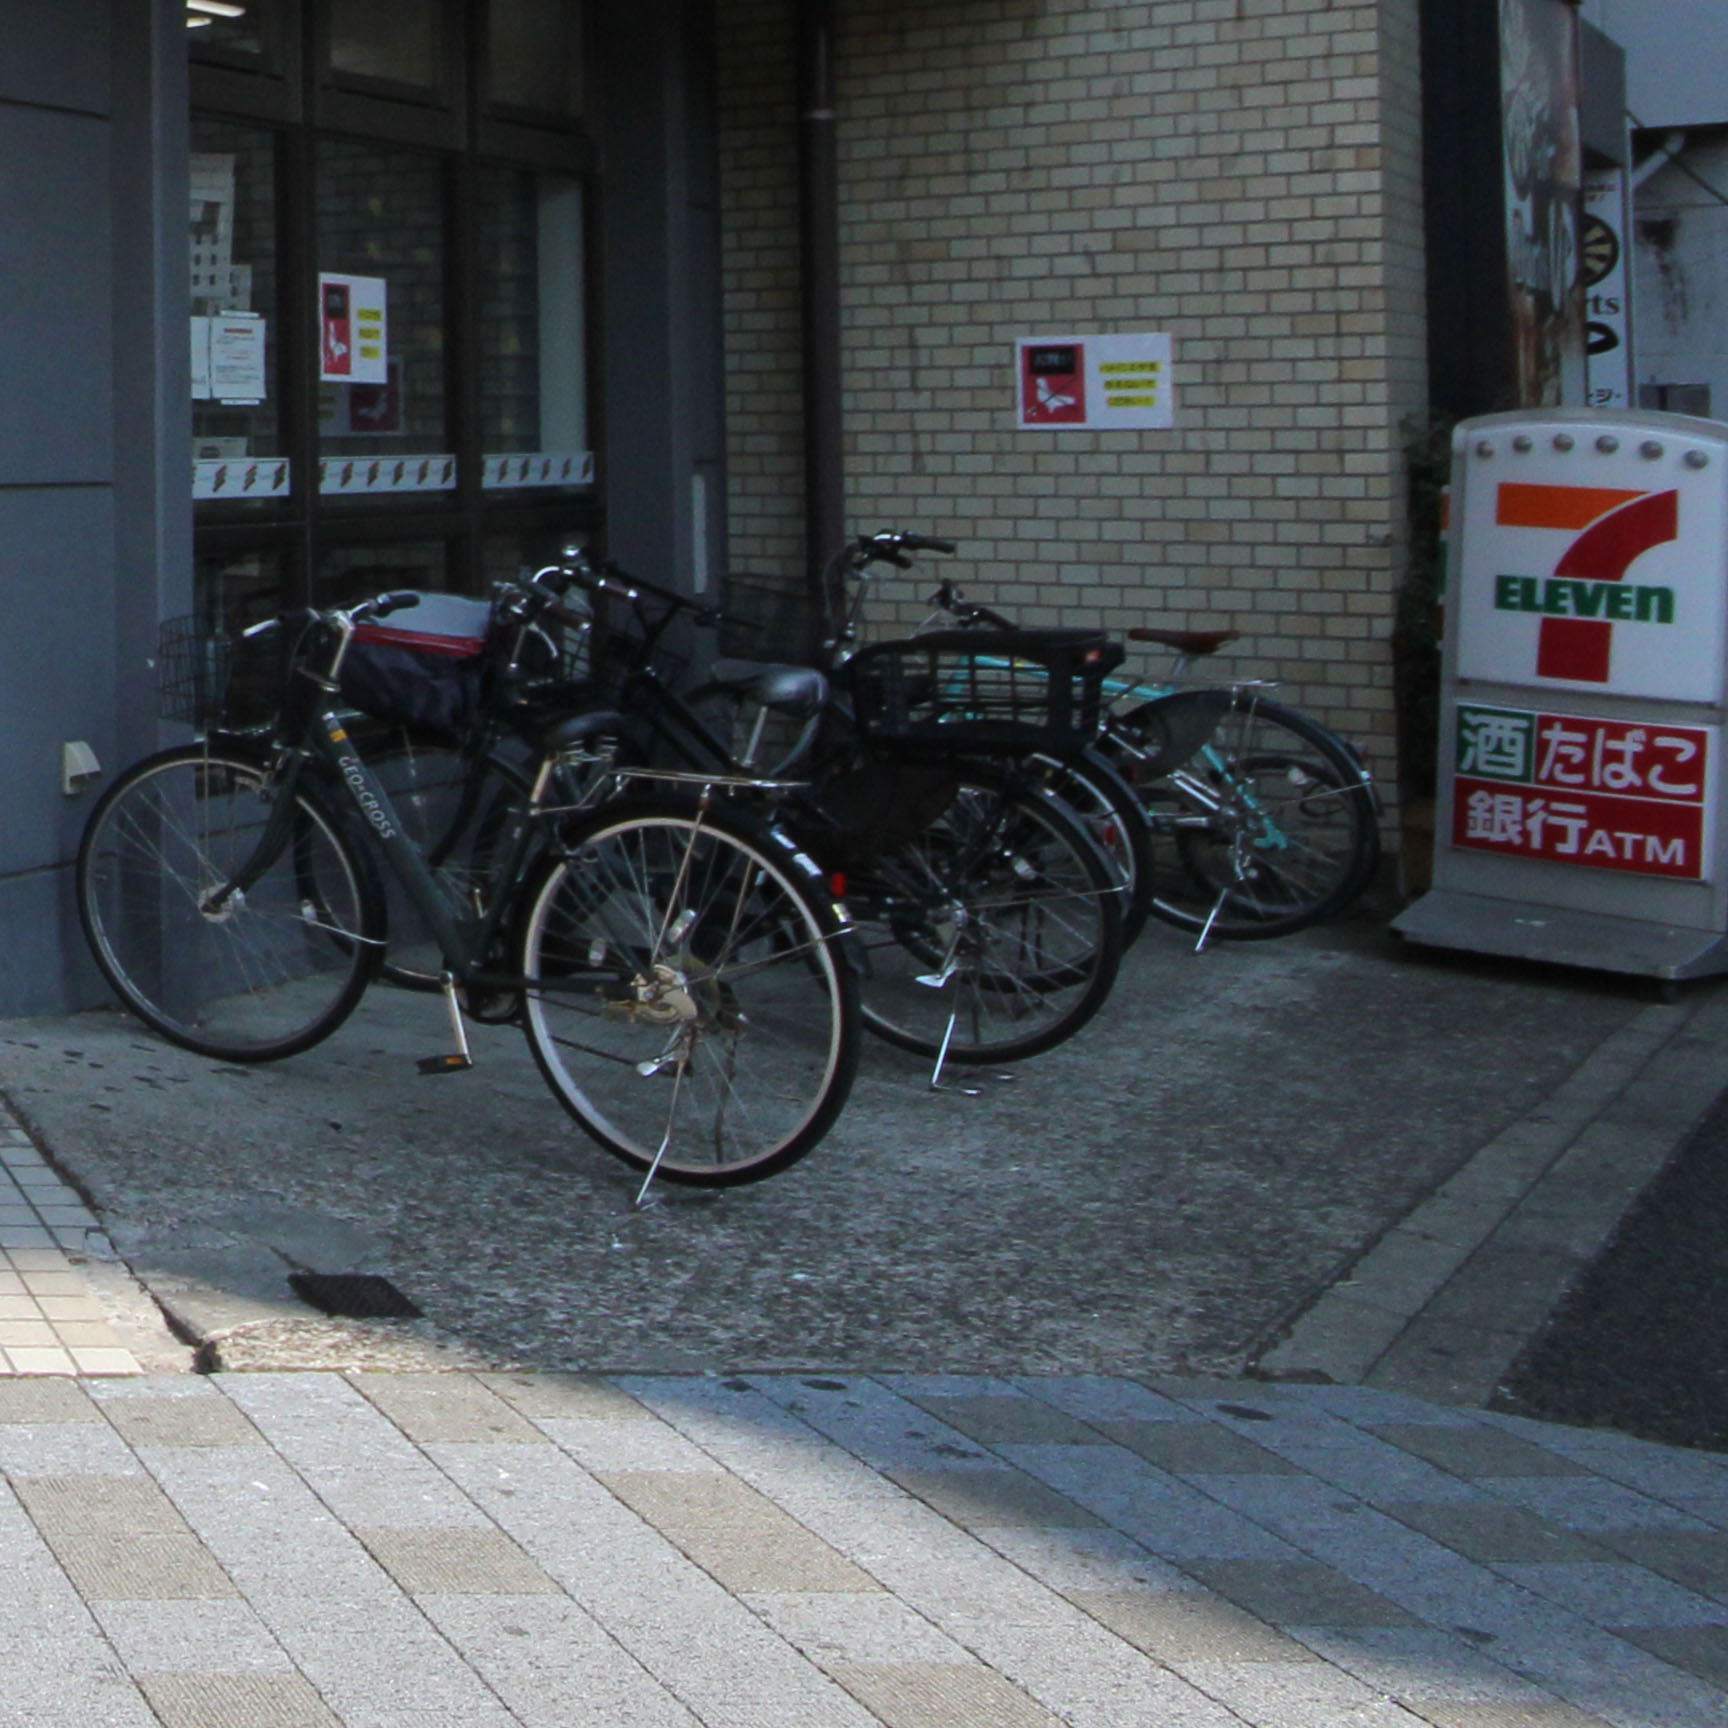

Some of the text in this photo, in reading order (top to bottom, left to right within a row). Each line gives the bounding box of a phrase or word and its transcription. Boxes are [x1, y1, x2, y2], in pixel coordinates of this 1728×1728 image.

[1461, 711, 1698, 796] 酒 たばこ
[1466, 788, 1686, 866] 銀行ATM
